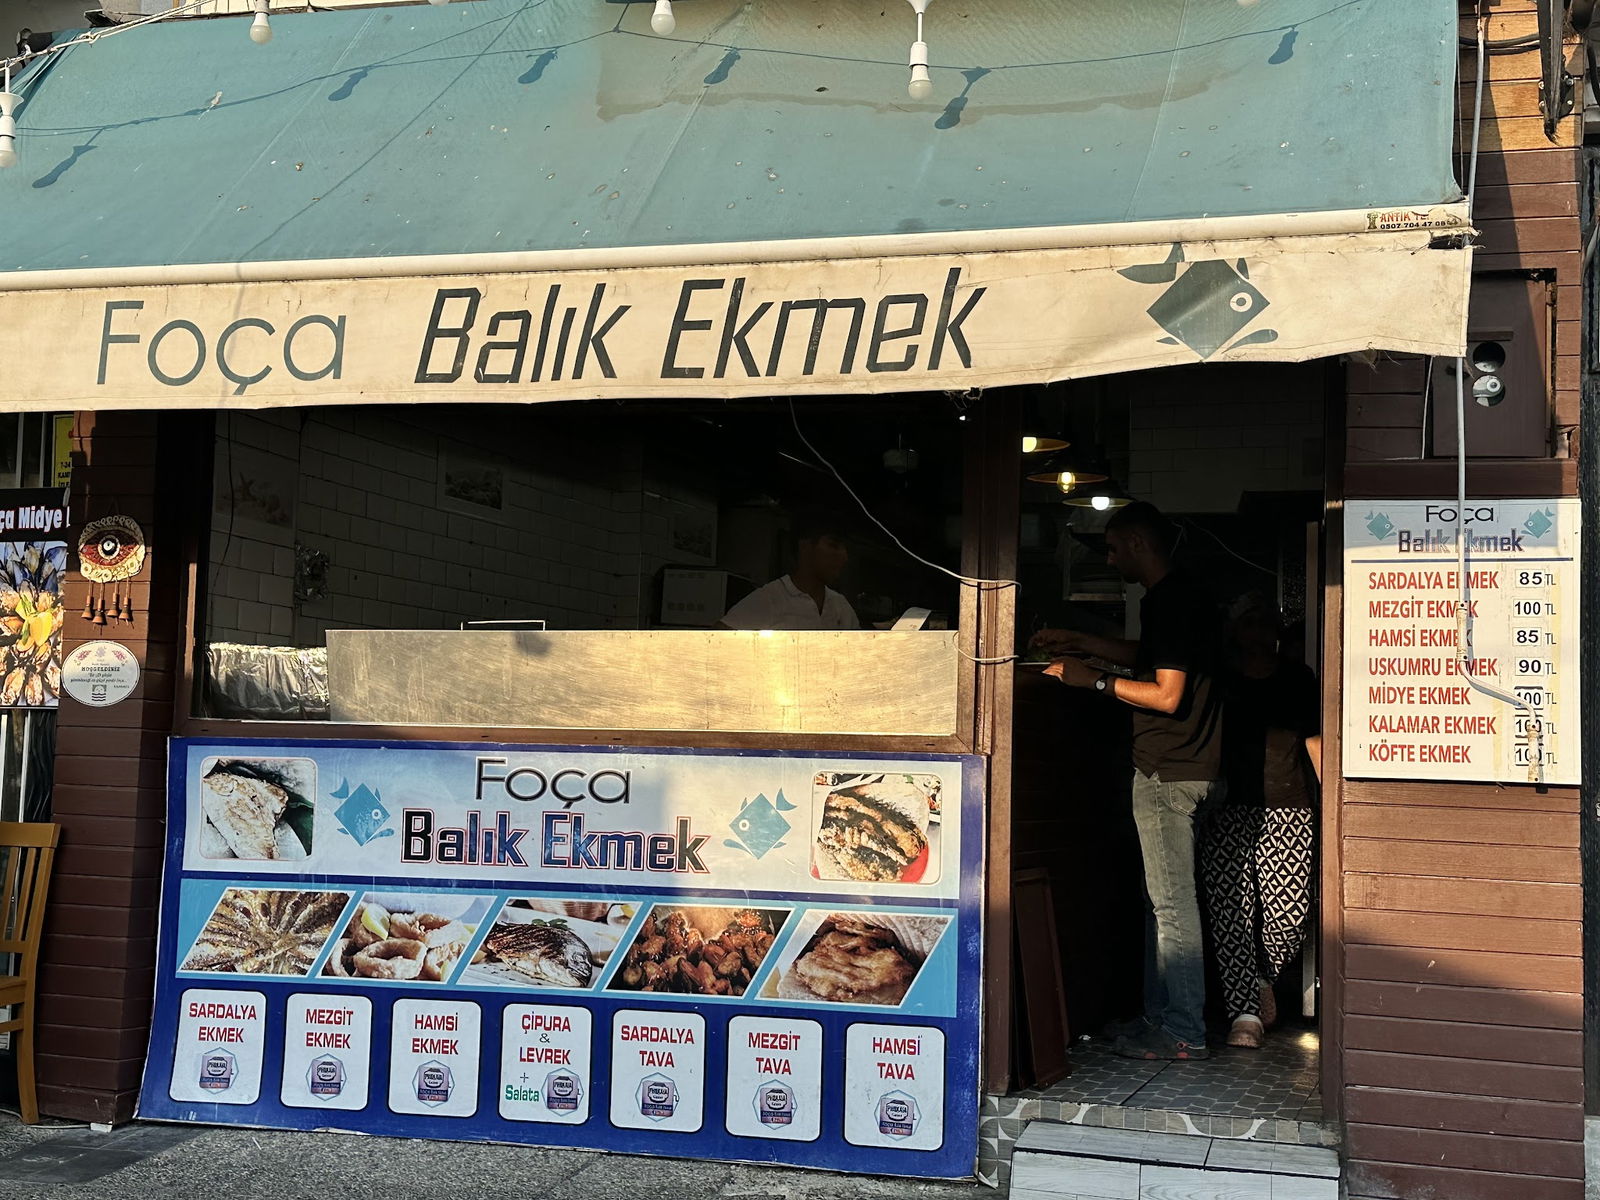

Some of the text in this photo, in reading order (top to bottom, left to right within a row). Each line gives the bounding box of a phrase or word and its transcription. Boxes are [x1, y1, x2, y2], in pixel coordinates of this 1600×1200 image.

[97, 268, 987, 395] Foça Balık Ekmek
[19, 505, 62, 533] Midye
[1398, 528, 1450, 553] Balık
[1368, 571, 1556, 589] SARDALYA EMEK 85 TL
[1369, 595, 1556, 618] MEZGİT EKMK 100 TL
[1369, 624, 1416, 647] HAMSİ
[1516, 630, 1539, 644] 85
[1545, 633, 1556, 645] TL
[1368, 658, 1441, 676] USKUMRU
[1518, 659, 1541, 673] 90
[1545, 662, 1556, 674] TL
[1369, 681, 1415, 704] MİDYE
[1419, 686, 1471, 705] EKMEK
[1545, 692, 1557, 704] TL
[1369, 715, 1440, 734] KALAMAR
[1444, 716, 1496, 735] EKMEK
[1546, 722, 1557, 734] TL
[1369, 739, 1415, 762] KÖFTE
[1419, 744, 1471, 763] EKMEK
[1546, 752, 1557, 764] TL
[475, 756, 632, 810] Foça
[400, 807, 710, 874] Balık Ekmek
[189, 1002, 257, 1020] SARDALYA
[306, 1006, 354, 1026] MEZGİT
[414, 1012, 458, 1031] HAMSİ
[521, 1011, 571, 1034] ÇİPURA
[198, 1026, 244, 1043] EKMEK
[305, 1032, 351, 1049] EKMEK
[539, 1033, 550, 1044] &
[621, 1025, 694, 1044] SARDALYA
[748, 1030, 800, 1051] MEZGİT
[412, 1037, 459, 1055] EKMEK
[872, 1036, 921, 1056] HAMSİ
[519, 1047, 571, 1065] LEVREK
[639, 1050, 674, 1068] TAVA
[755, 1057, 792, 1075] TAVA
[877, 1062, 915, 1080] TAVA
[505, 1085, 540, 1102] Salata
